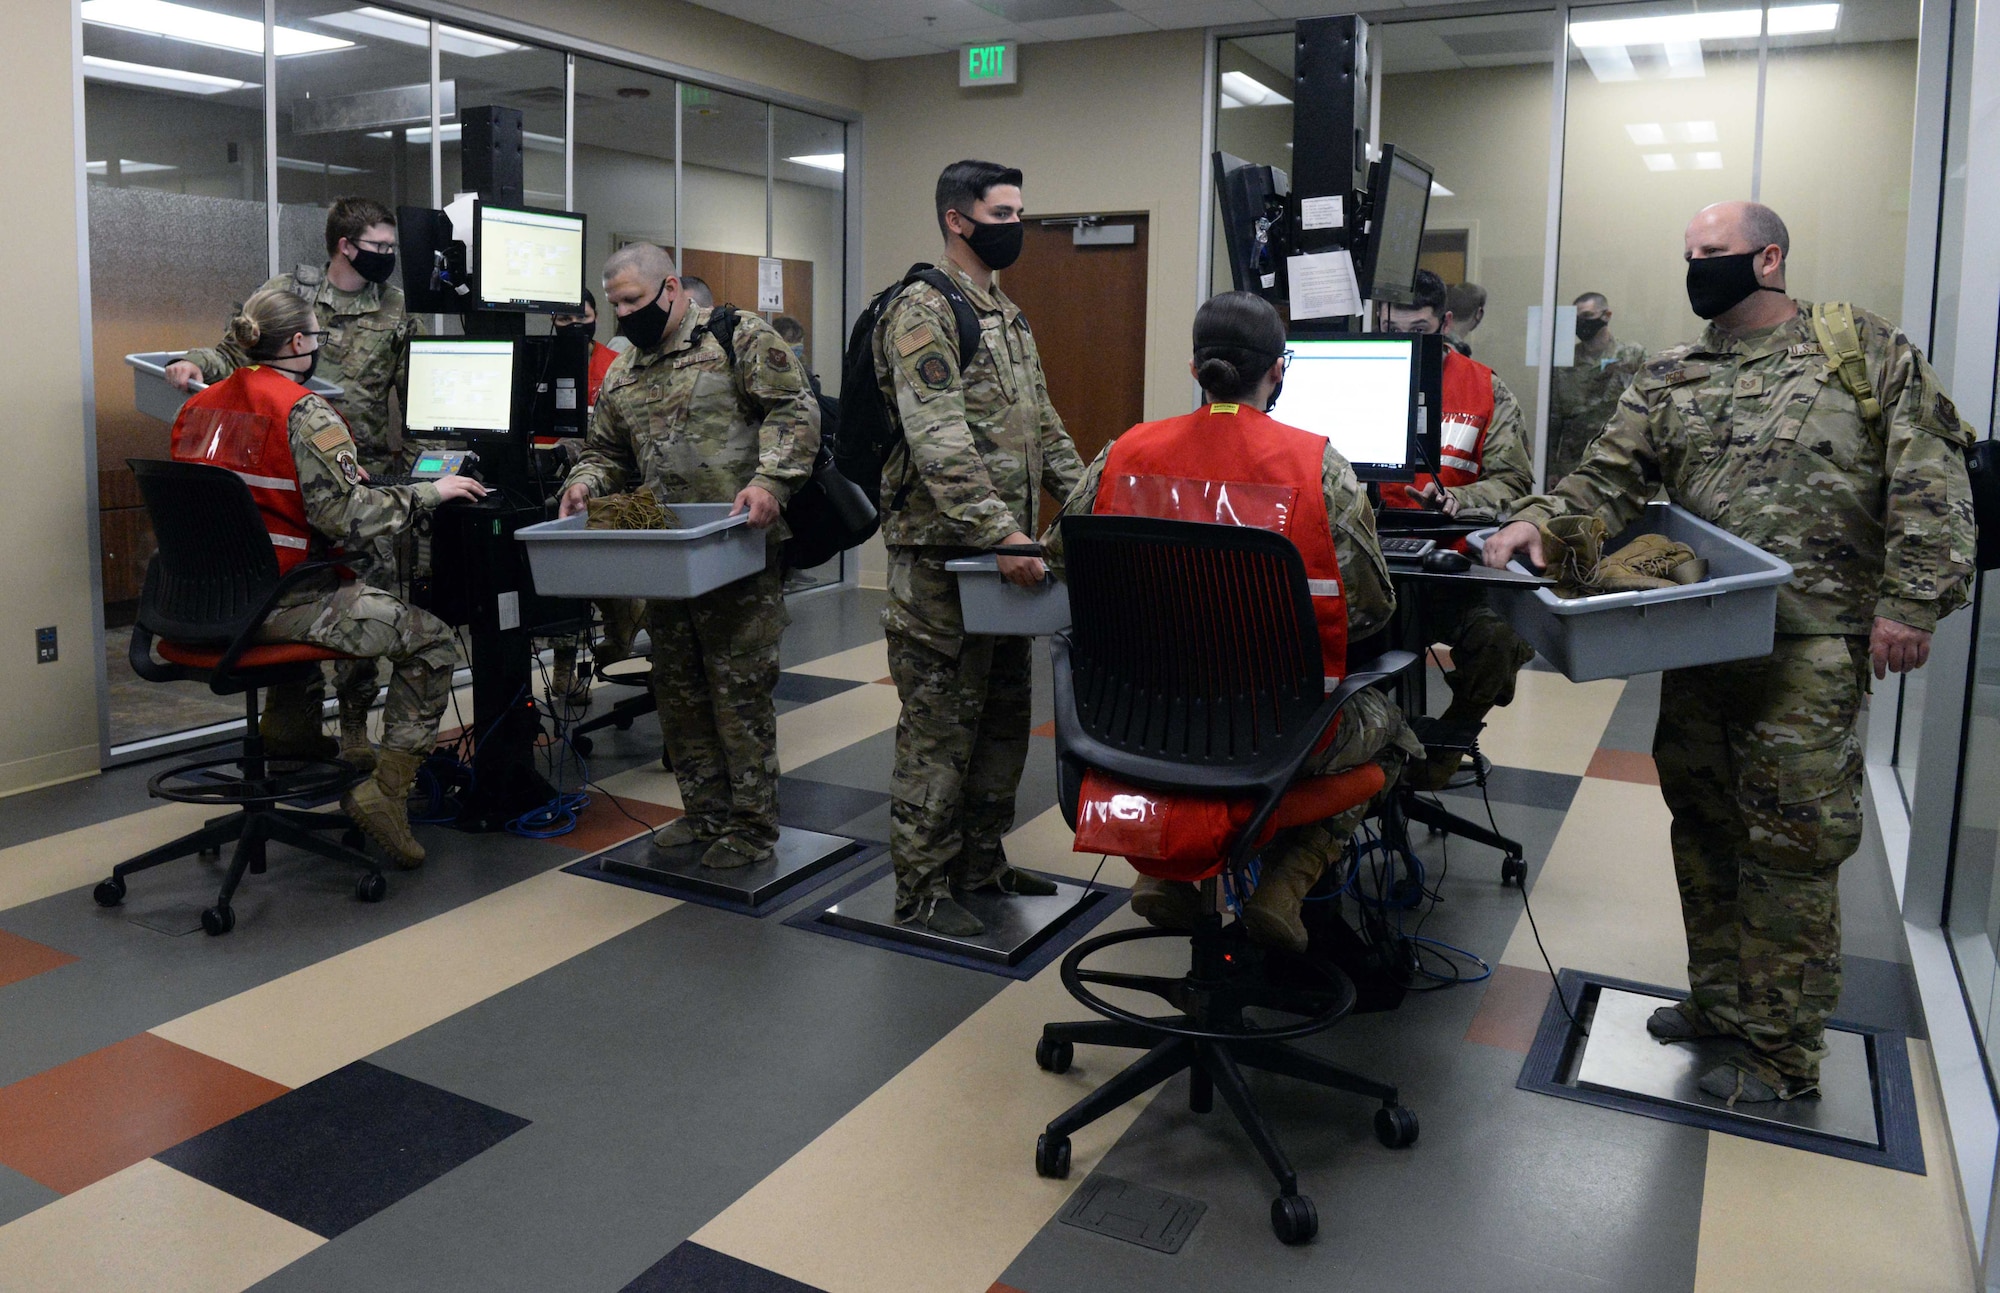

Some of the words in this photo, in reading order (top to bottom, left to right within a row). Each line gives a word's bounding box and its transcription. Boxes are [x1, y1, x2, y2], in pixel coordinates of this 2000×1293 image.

[969, 45, 1006, 79] EXIT
[1791, 344, 1815, 355] U.S.
[697, 351, 716, 361] FORCE
[1665, 370, 1686, 384] PECK
